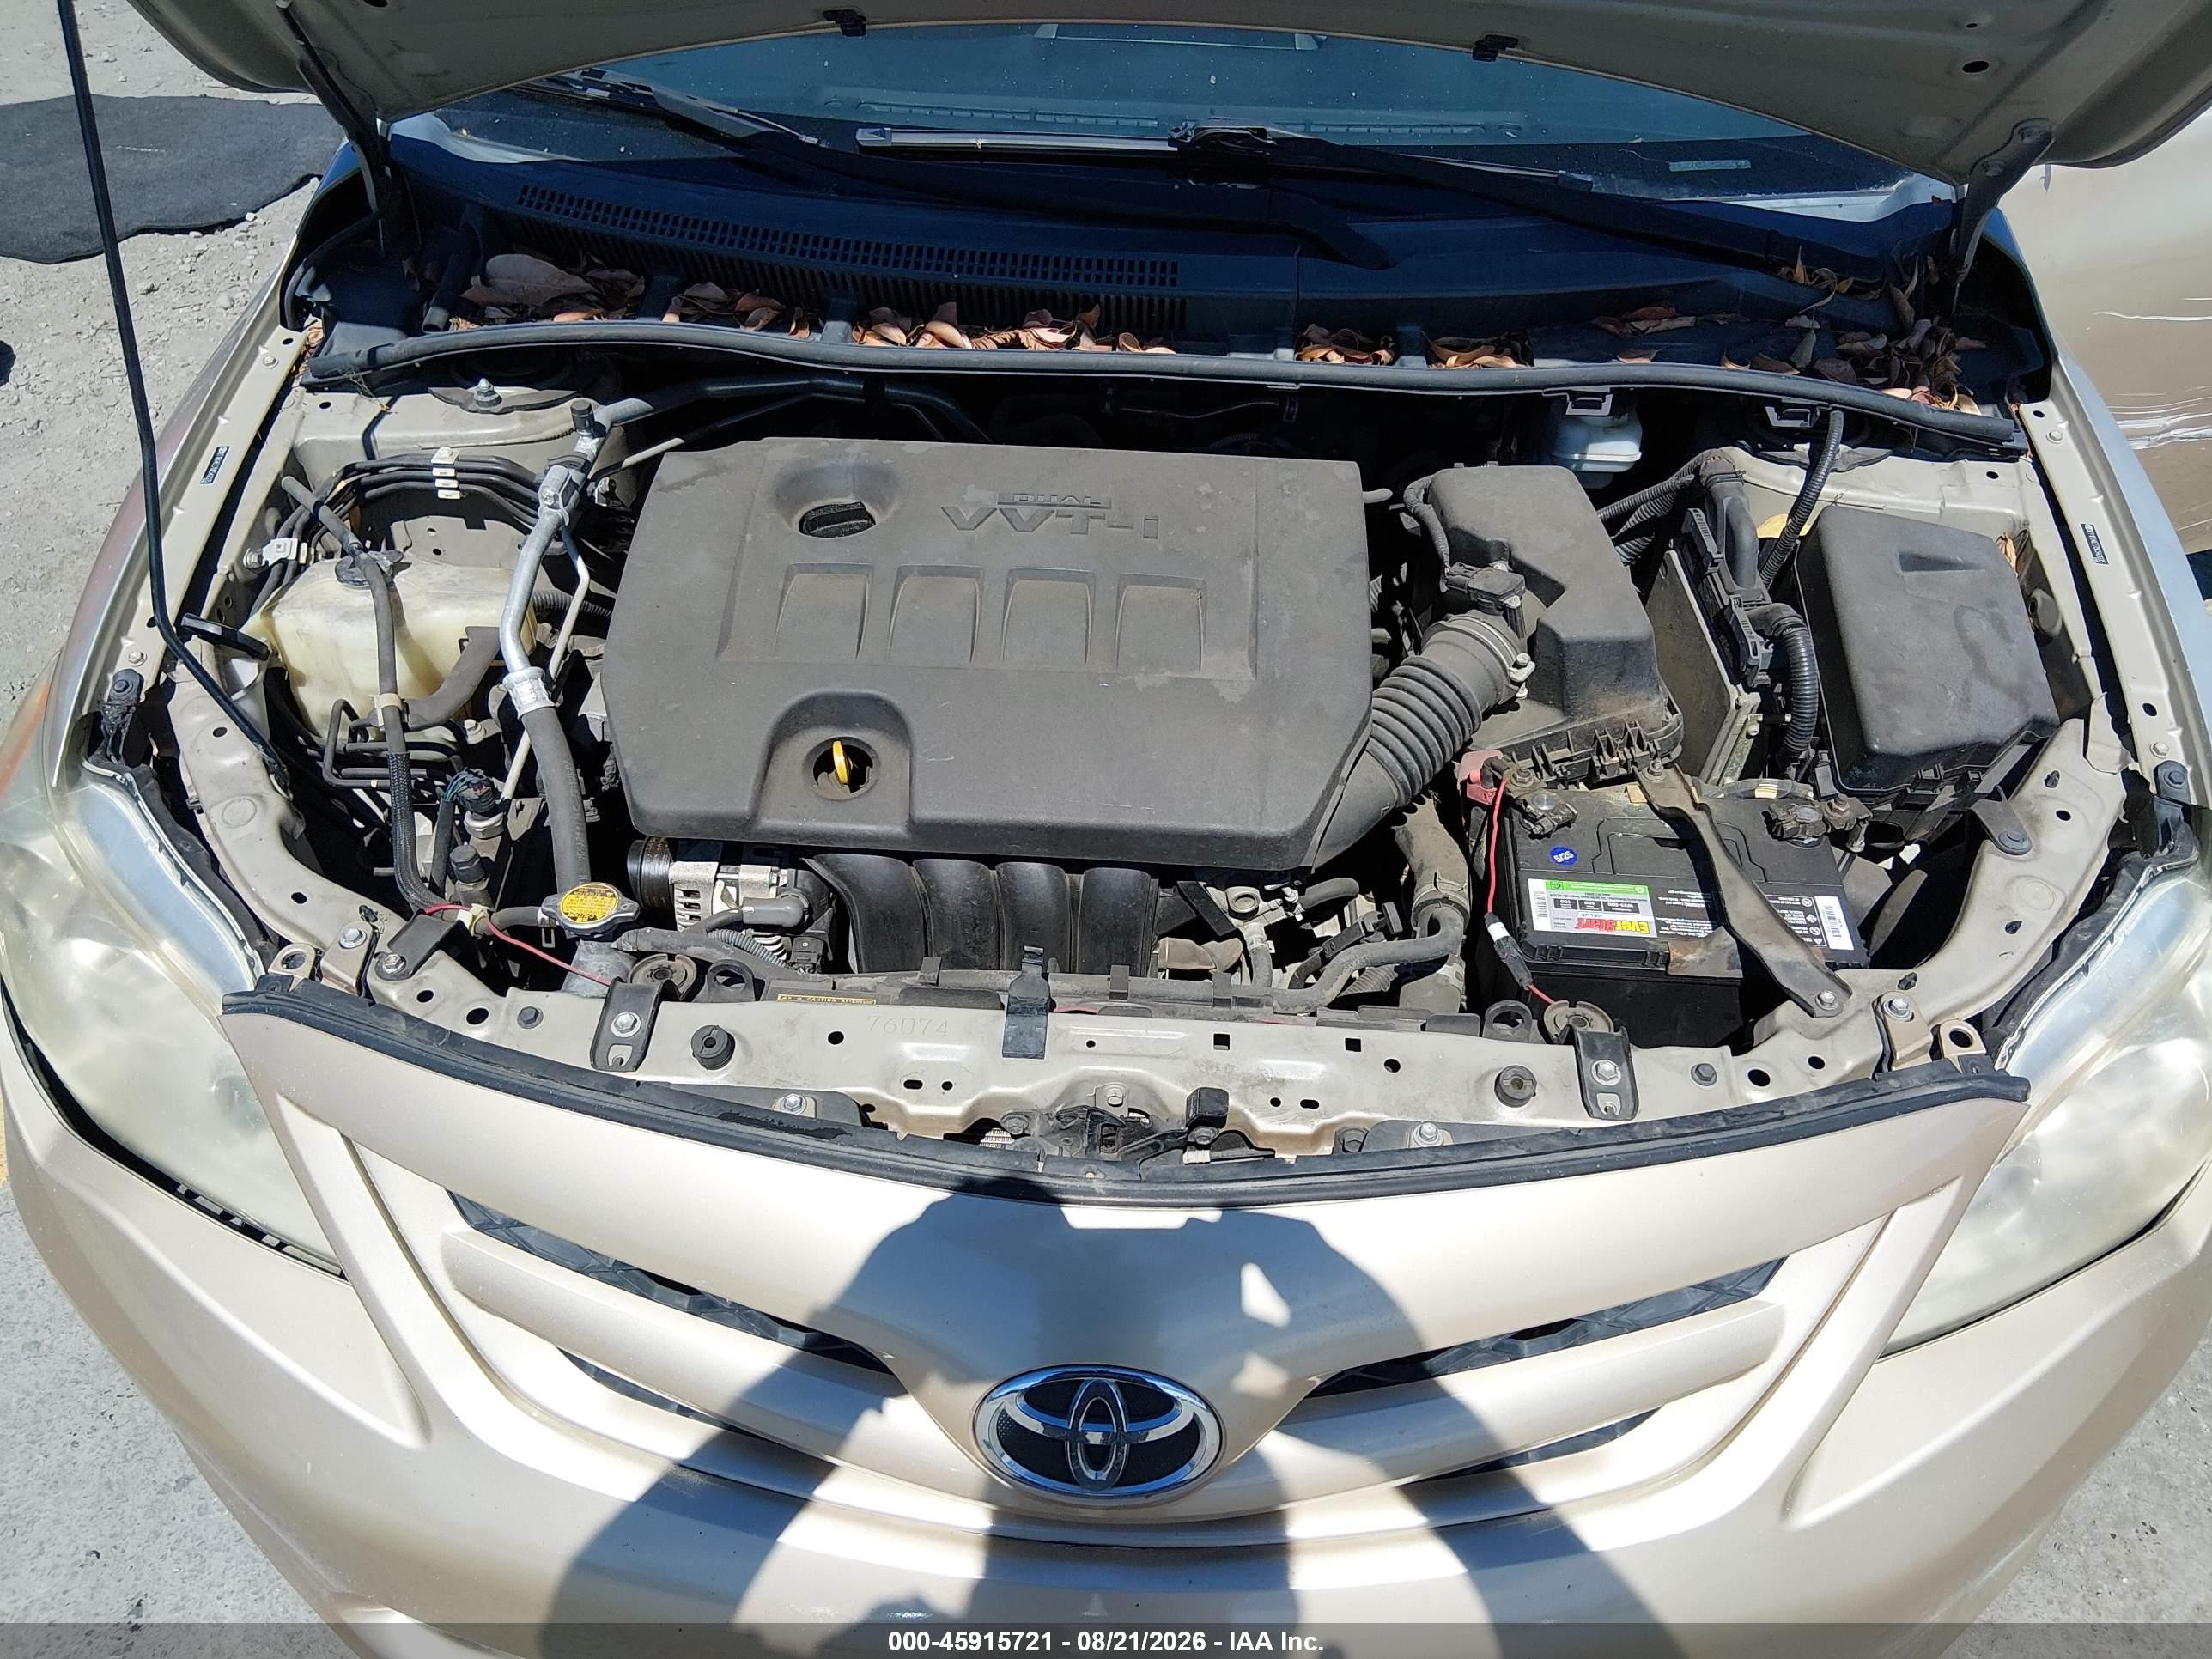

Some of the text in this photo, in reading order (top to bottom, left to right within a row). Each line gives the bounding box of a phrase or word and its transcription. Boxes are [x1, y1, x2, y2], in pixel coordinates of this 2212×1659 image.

[1014, 493, 1102, 506] DUAL
[1553, 850, 1574, 863] 5/25
[1574, 916, 1650, 934] EverStart
[866, 1014, 950, 1036] 76074
